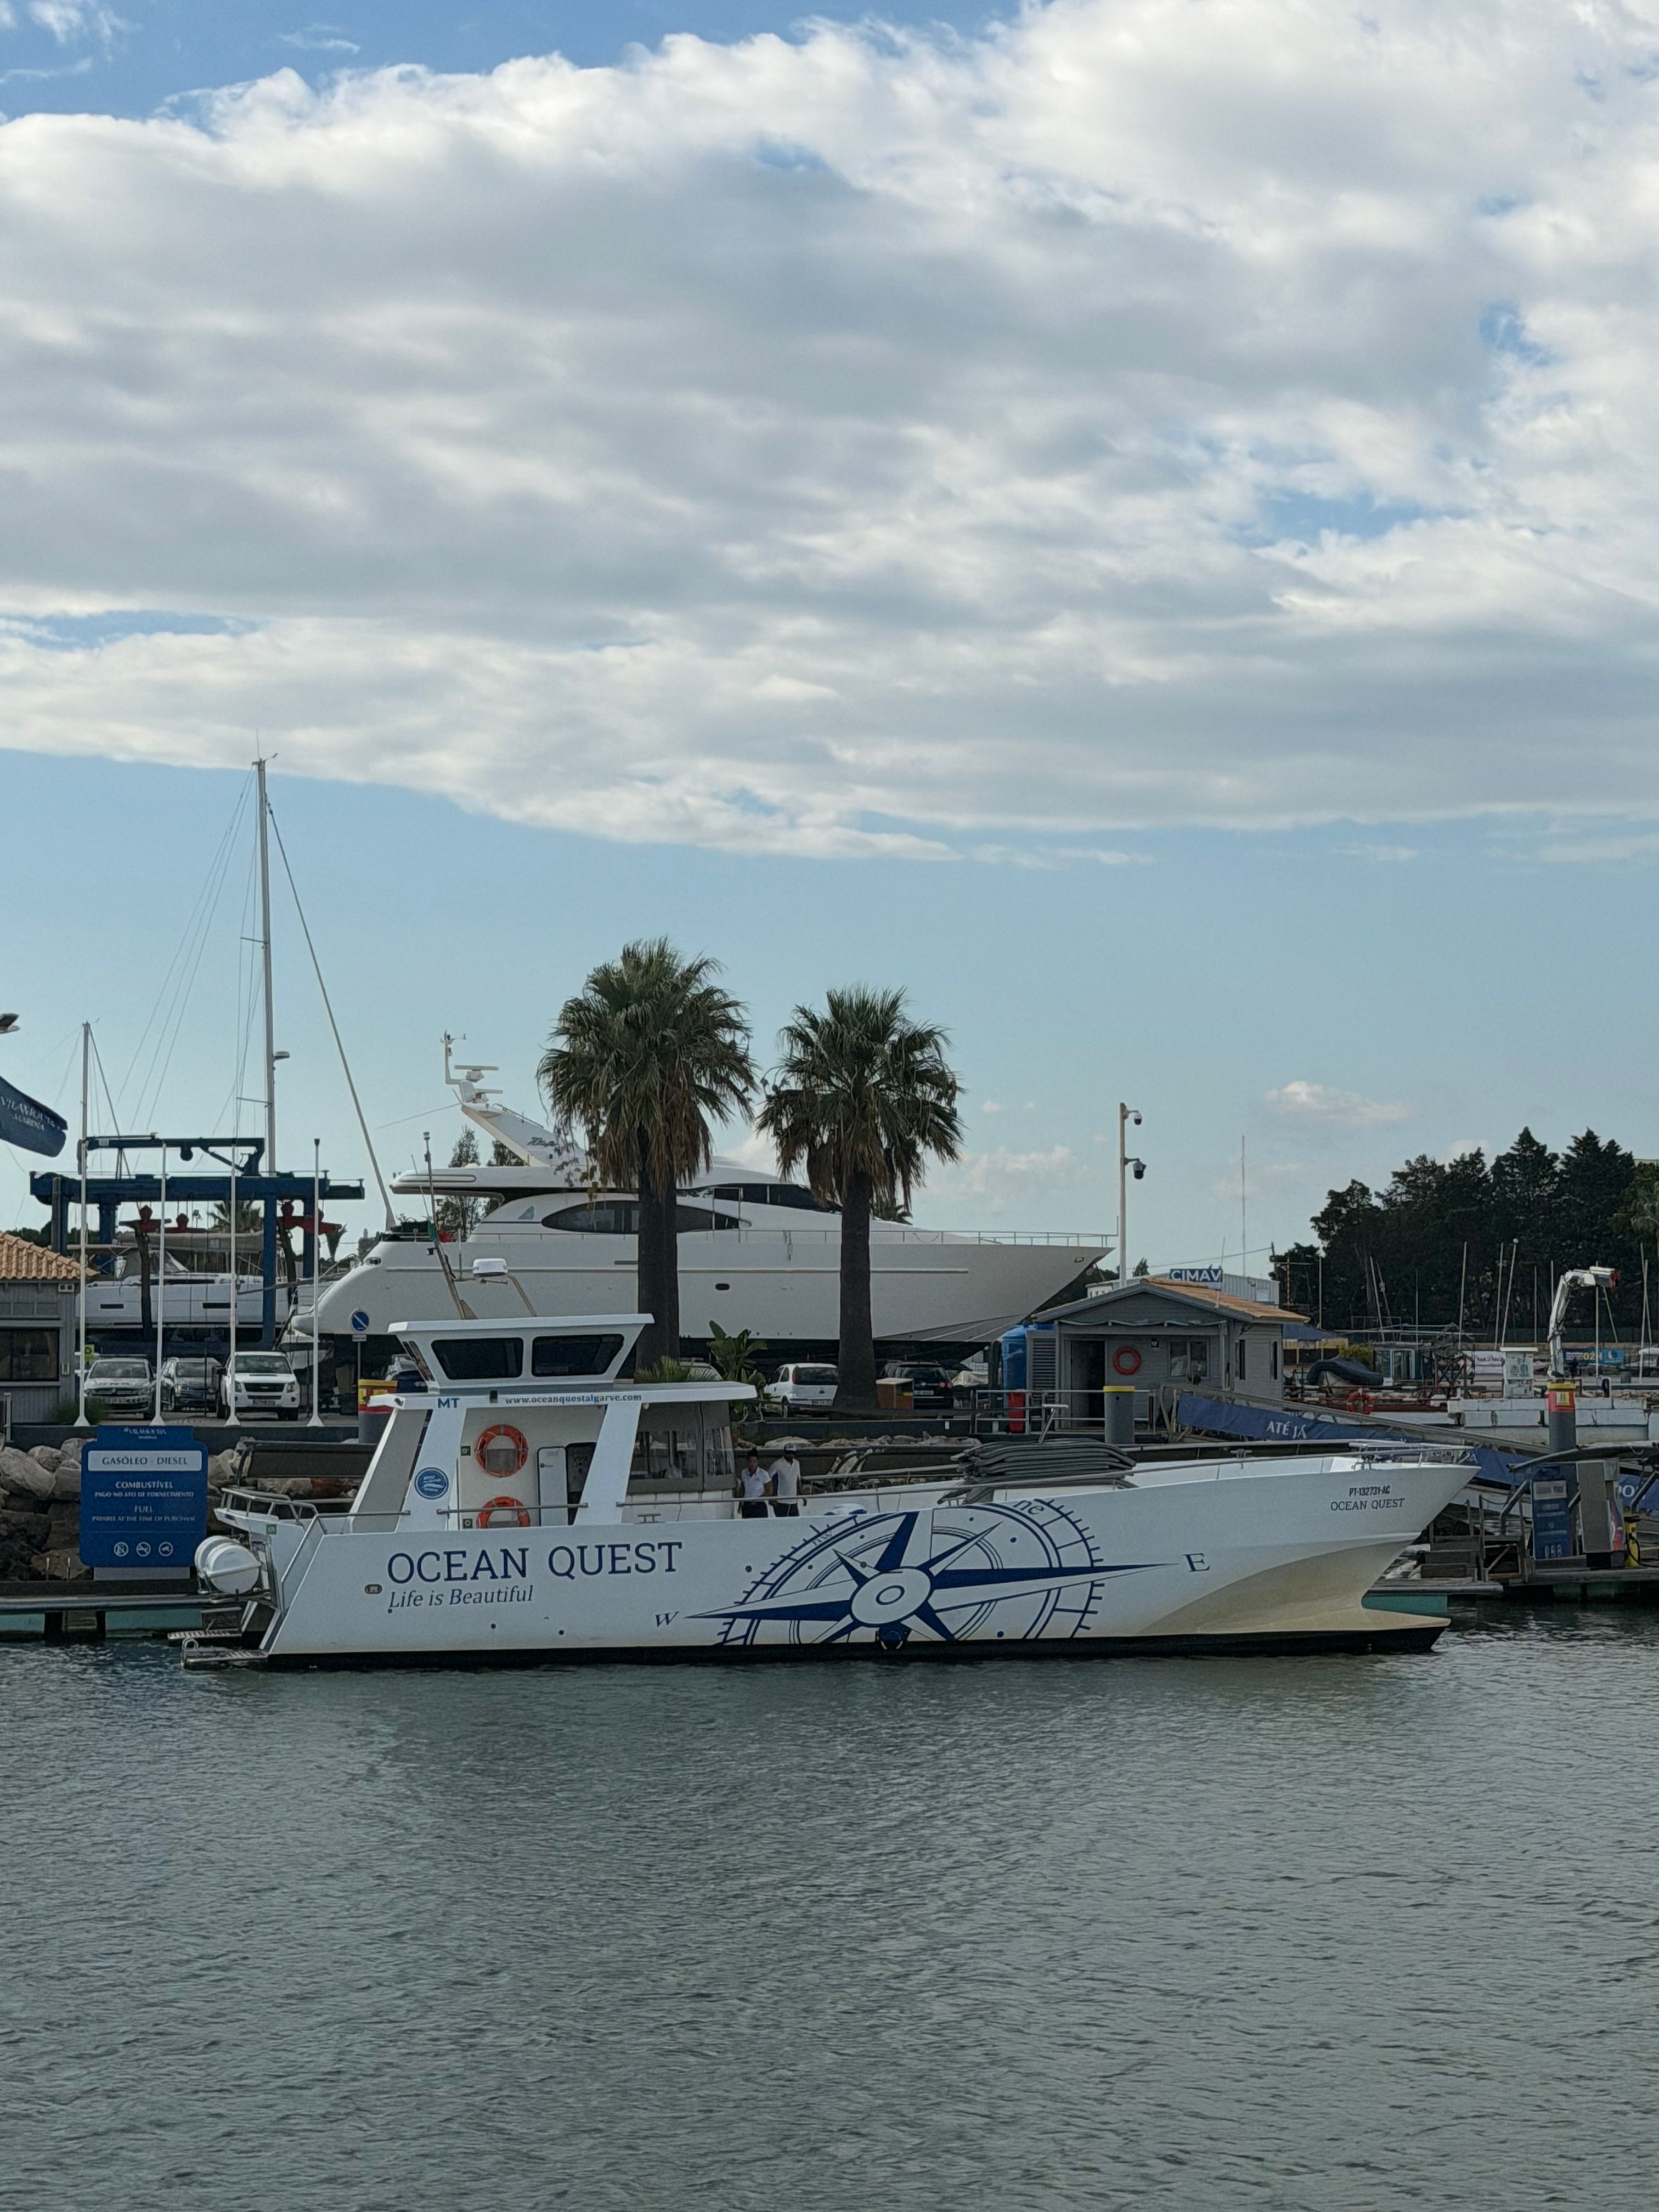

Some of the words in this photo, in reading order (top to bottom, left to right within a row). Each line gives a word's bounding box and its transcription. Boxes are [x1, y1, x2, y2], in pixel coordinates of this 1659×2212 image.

[437, 1397, 460, 1409] MT
[505, 1393, 642, 1406] www.oceanquestalgarve.com
[1266, 1420, 1290, 1436] ATÉ
[1292, 1424, 1307, 1440] JÁ
[101, 1455, 148, 1465] GASÓLEO
[157, 1457, 188, 1465] DIESEL
[115, 1480, 173, 1489] COMBUSTÍVEL
[1349, 1485, 1391, 1497] PT-132731-AC
[1330, 1500, 1368, 1511] OCEAN
[1372, 1498, 1406, 1510] QUEST
[387, 1548, 530, 1584] OCEAN
[548, 1542, 682, 1580] QUEST
[1182, 1553, 1210, 1572] E
[388, 1590, 424, 1608] Life
[428, 1590, 443, 1606] is
[449, 1585, 534, 1606] Beautiful
